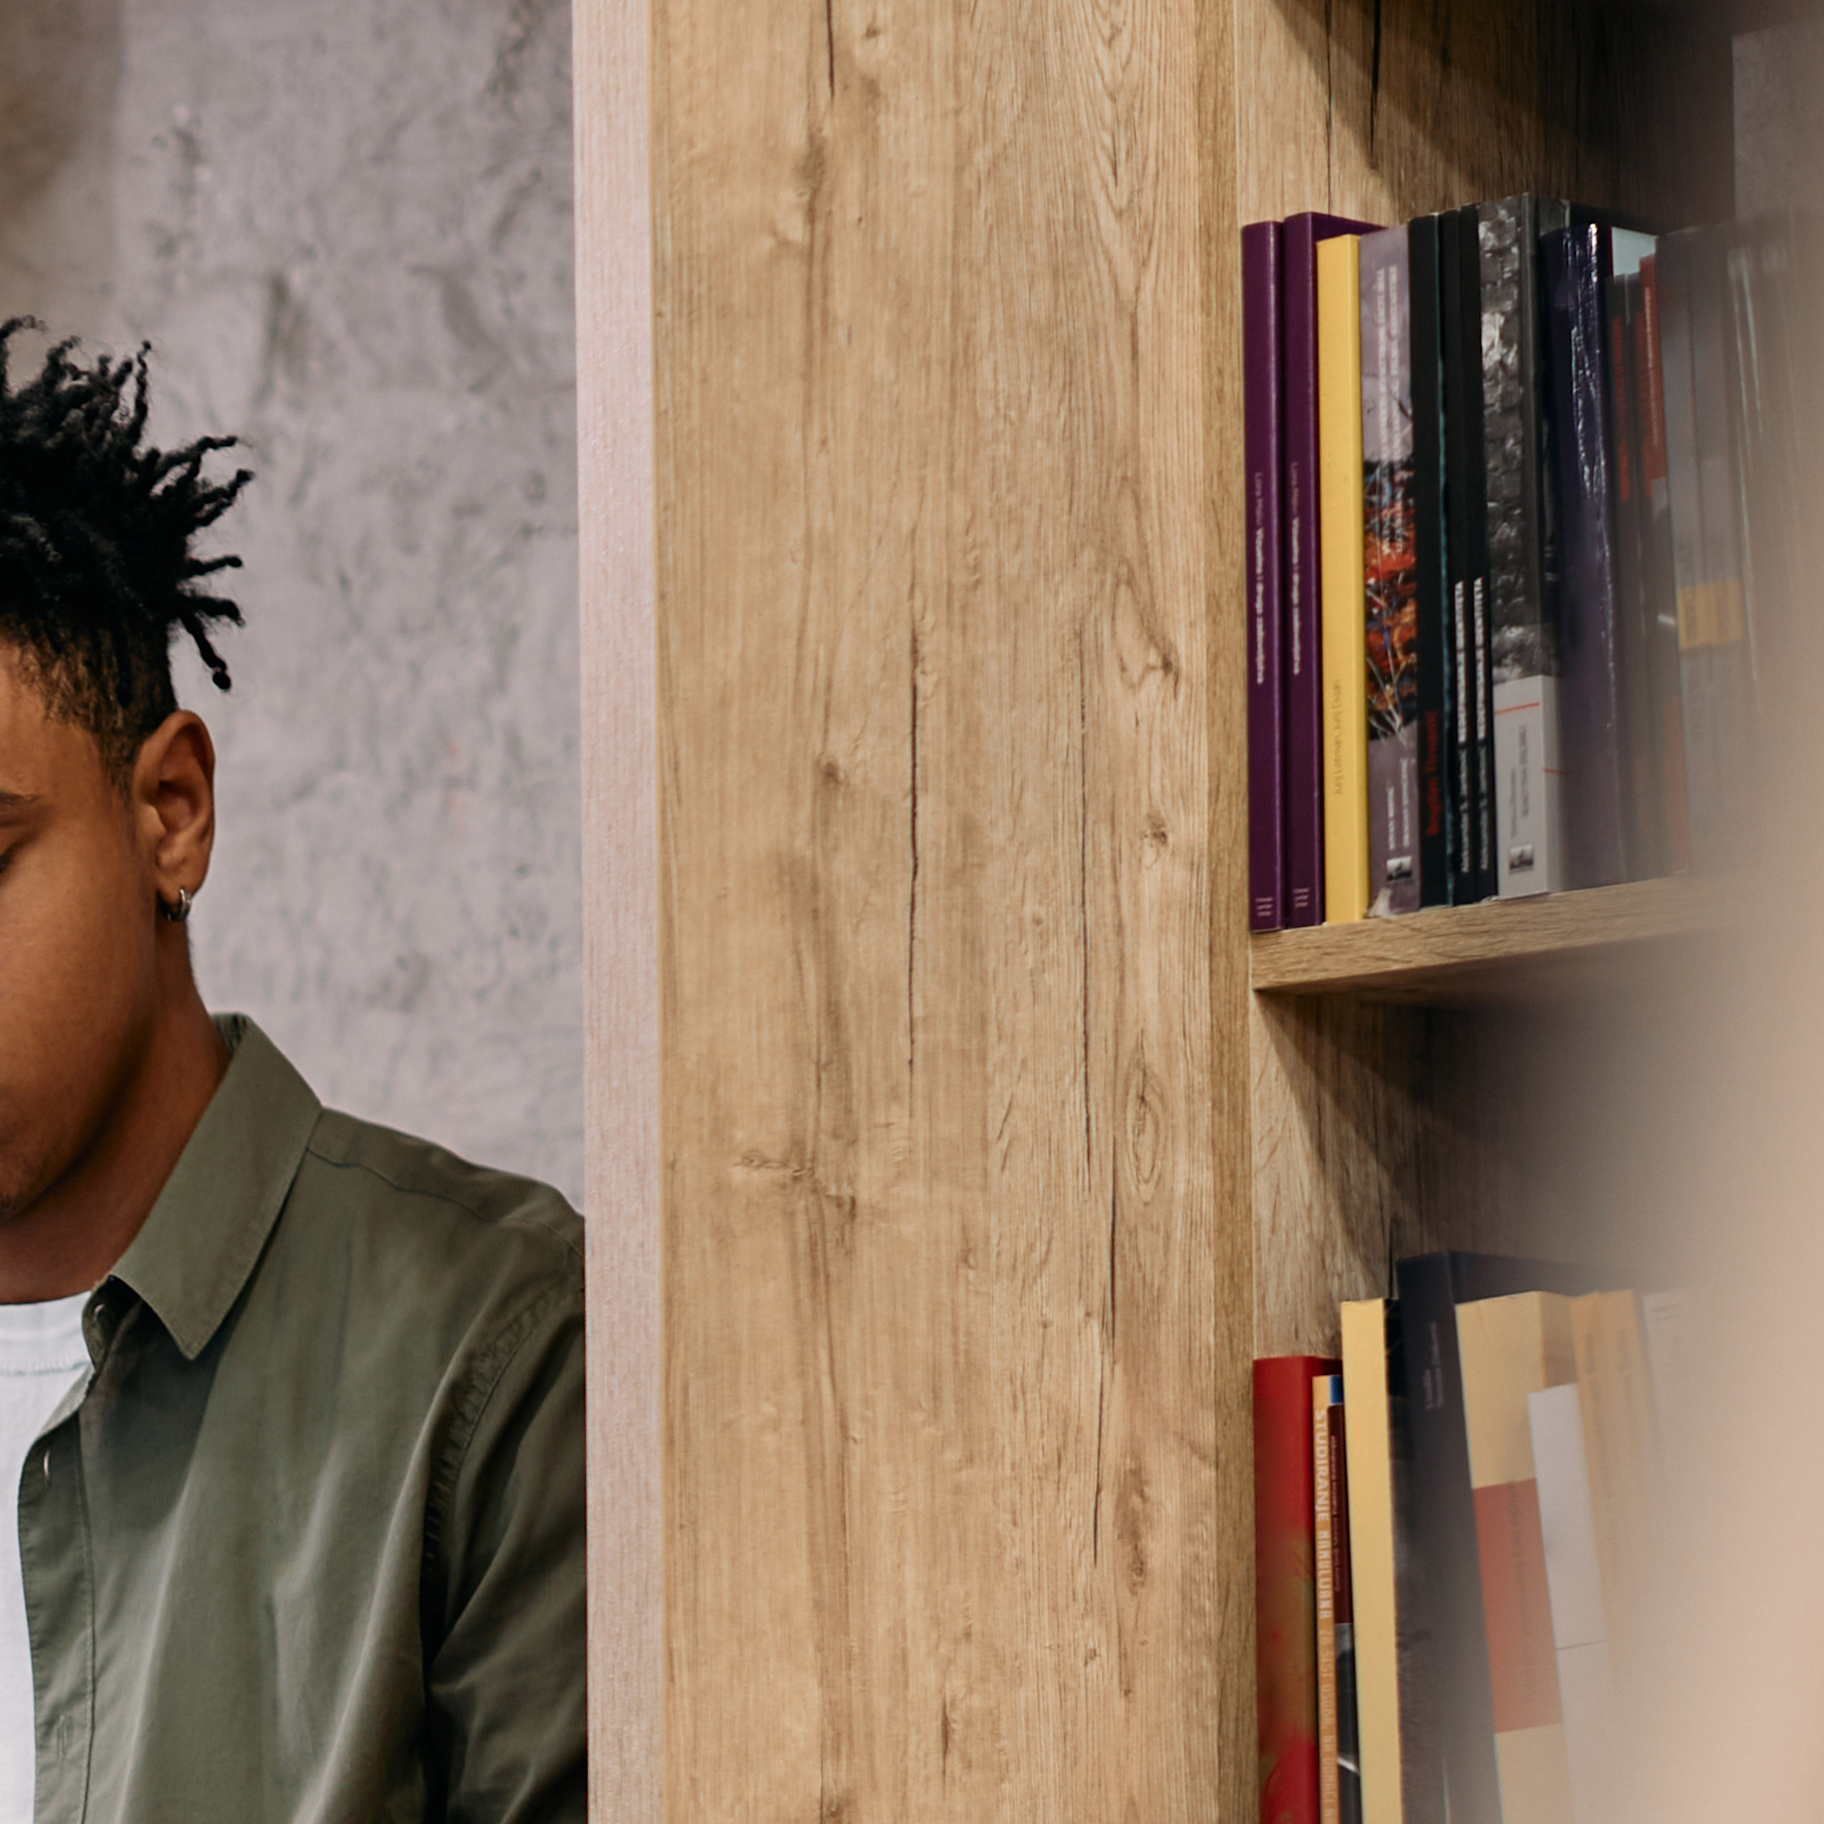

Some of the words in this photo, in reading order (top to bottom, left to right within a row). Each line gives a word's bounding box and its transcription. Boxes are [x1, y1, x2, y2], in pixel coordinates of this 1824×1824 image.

[1454, 580, 1465, 650] IDENTITETA
[1474, 577, 1484, 647] IDENTITETA
[1315, 1409, 1330, 1522] STUDIRANJE
